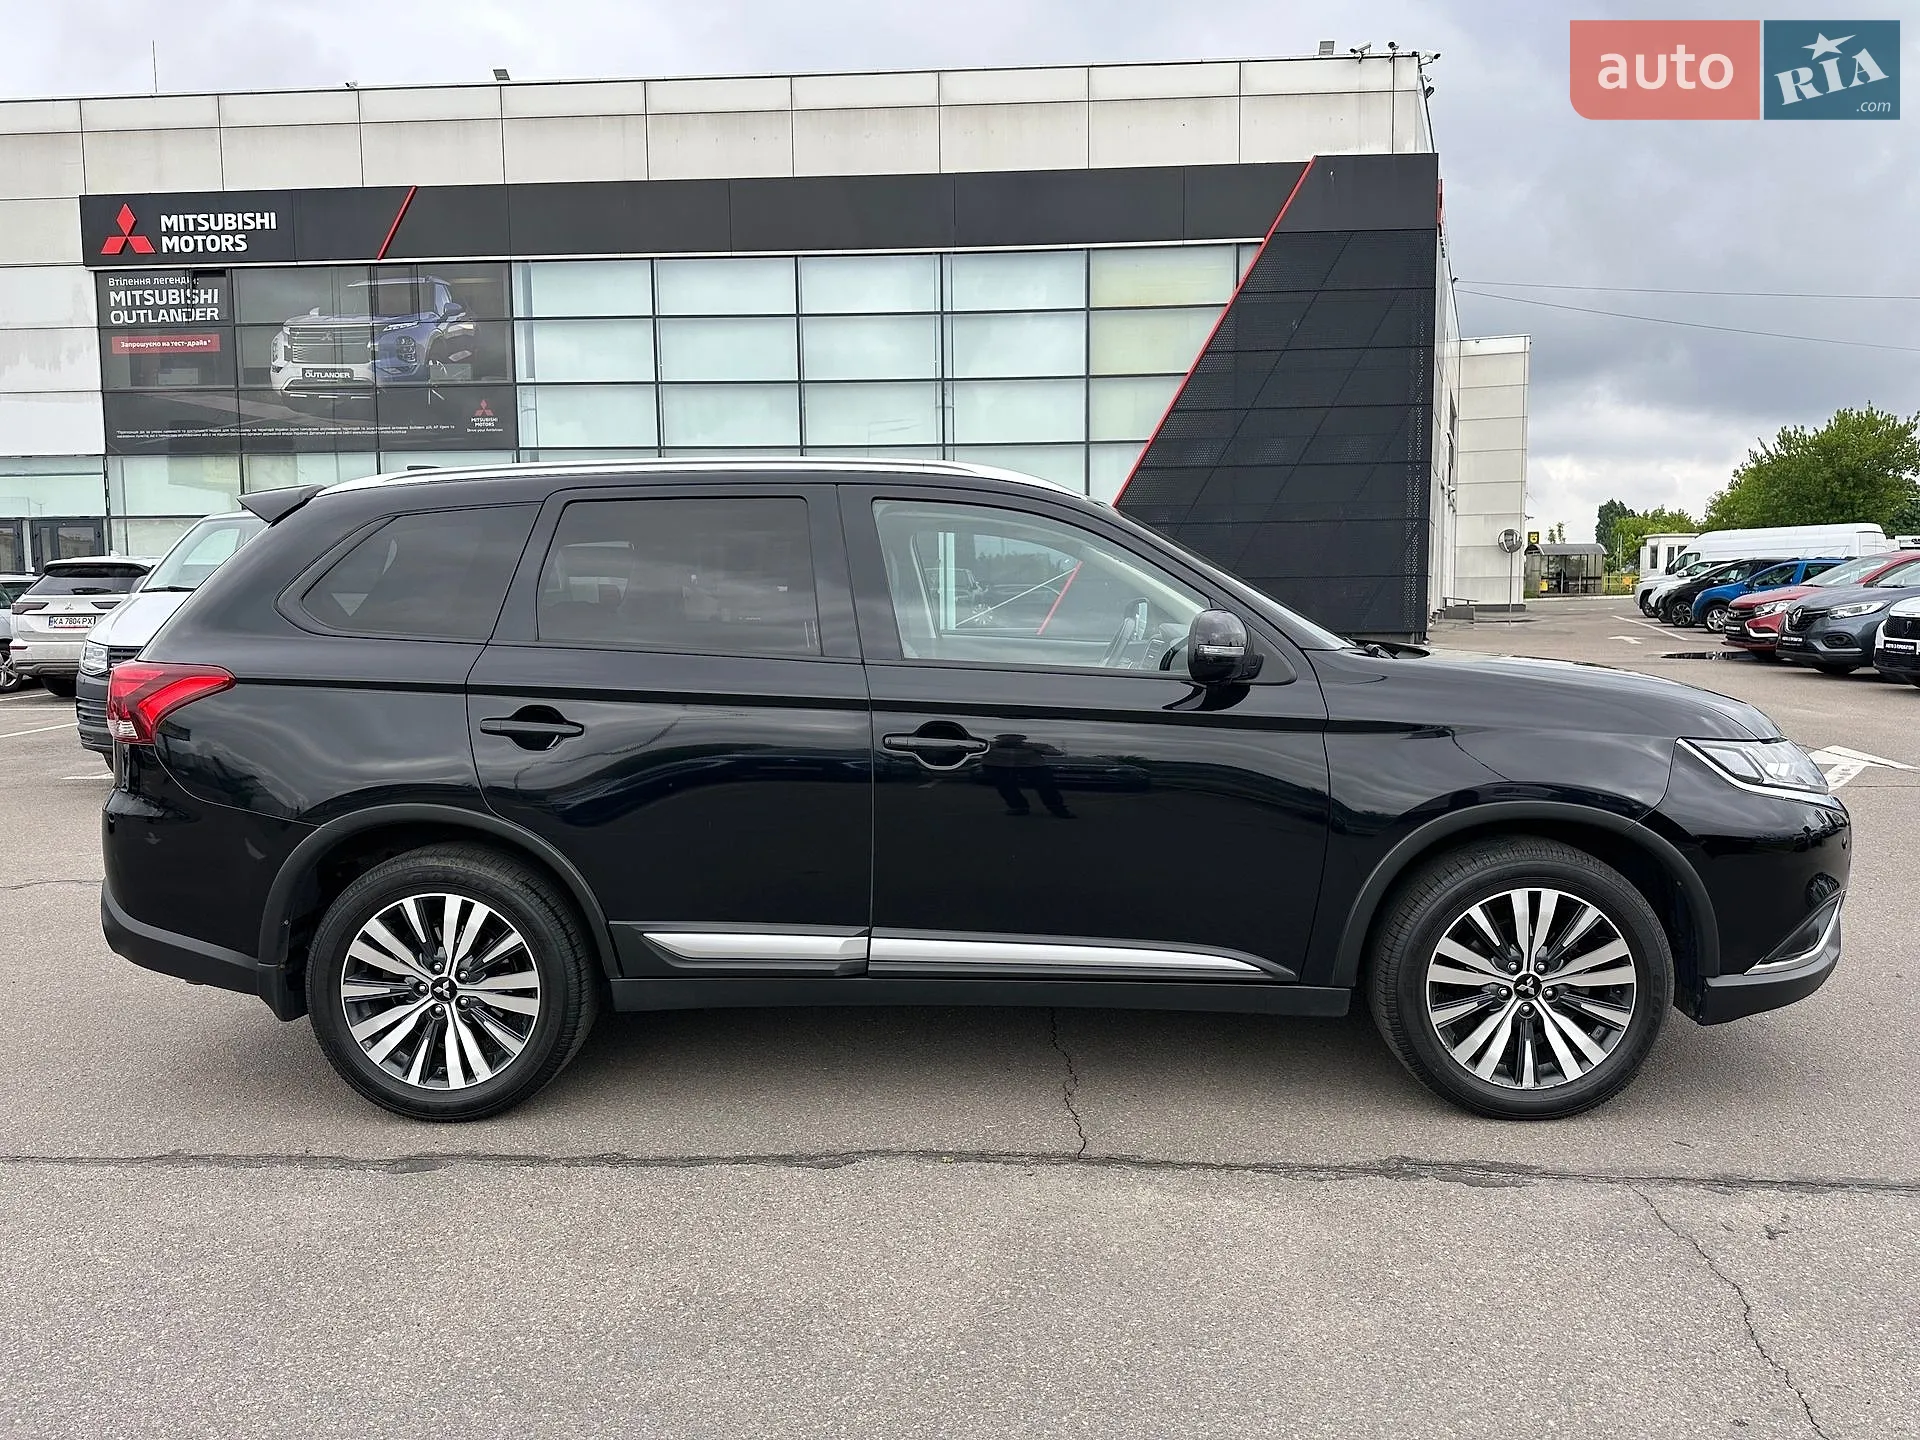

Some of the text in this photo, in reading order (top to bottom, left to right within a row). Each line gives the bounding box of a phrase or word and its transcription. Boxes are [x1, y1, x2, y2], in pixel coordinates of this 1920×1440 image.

[160, 211, 277, 232] MITSUBISHI
[161, 233, 248, 253] MOTORS
[108, 277, 151, 287] Втілення
[109, 288, 219, 307] MITSUBISHI
[110, 307, 220, 325] OUTLANDER
[304, 371, 351, 379] OUTLANDER
[54, 617, 63, 625] KA
